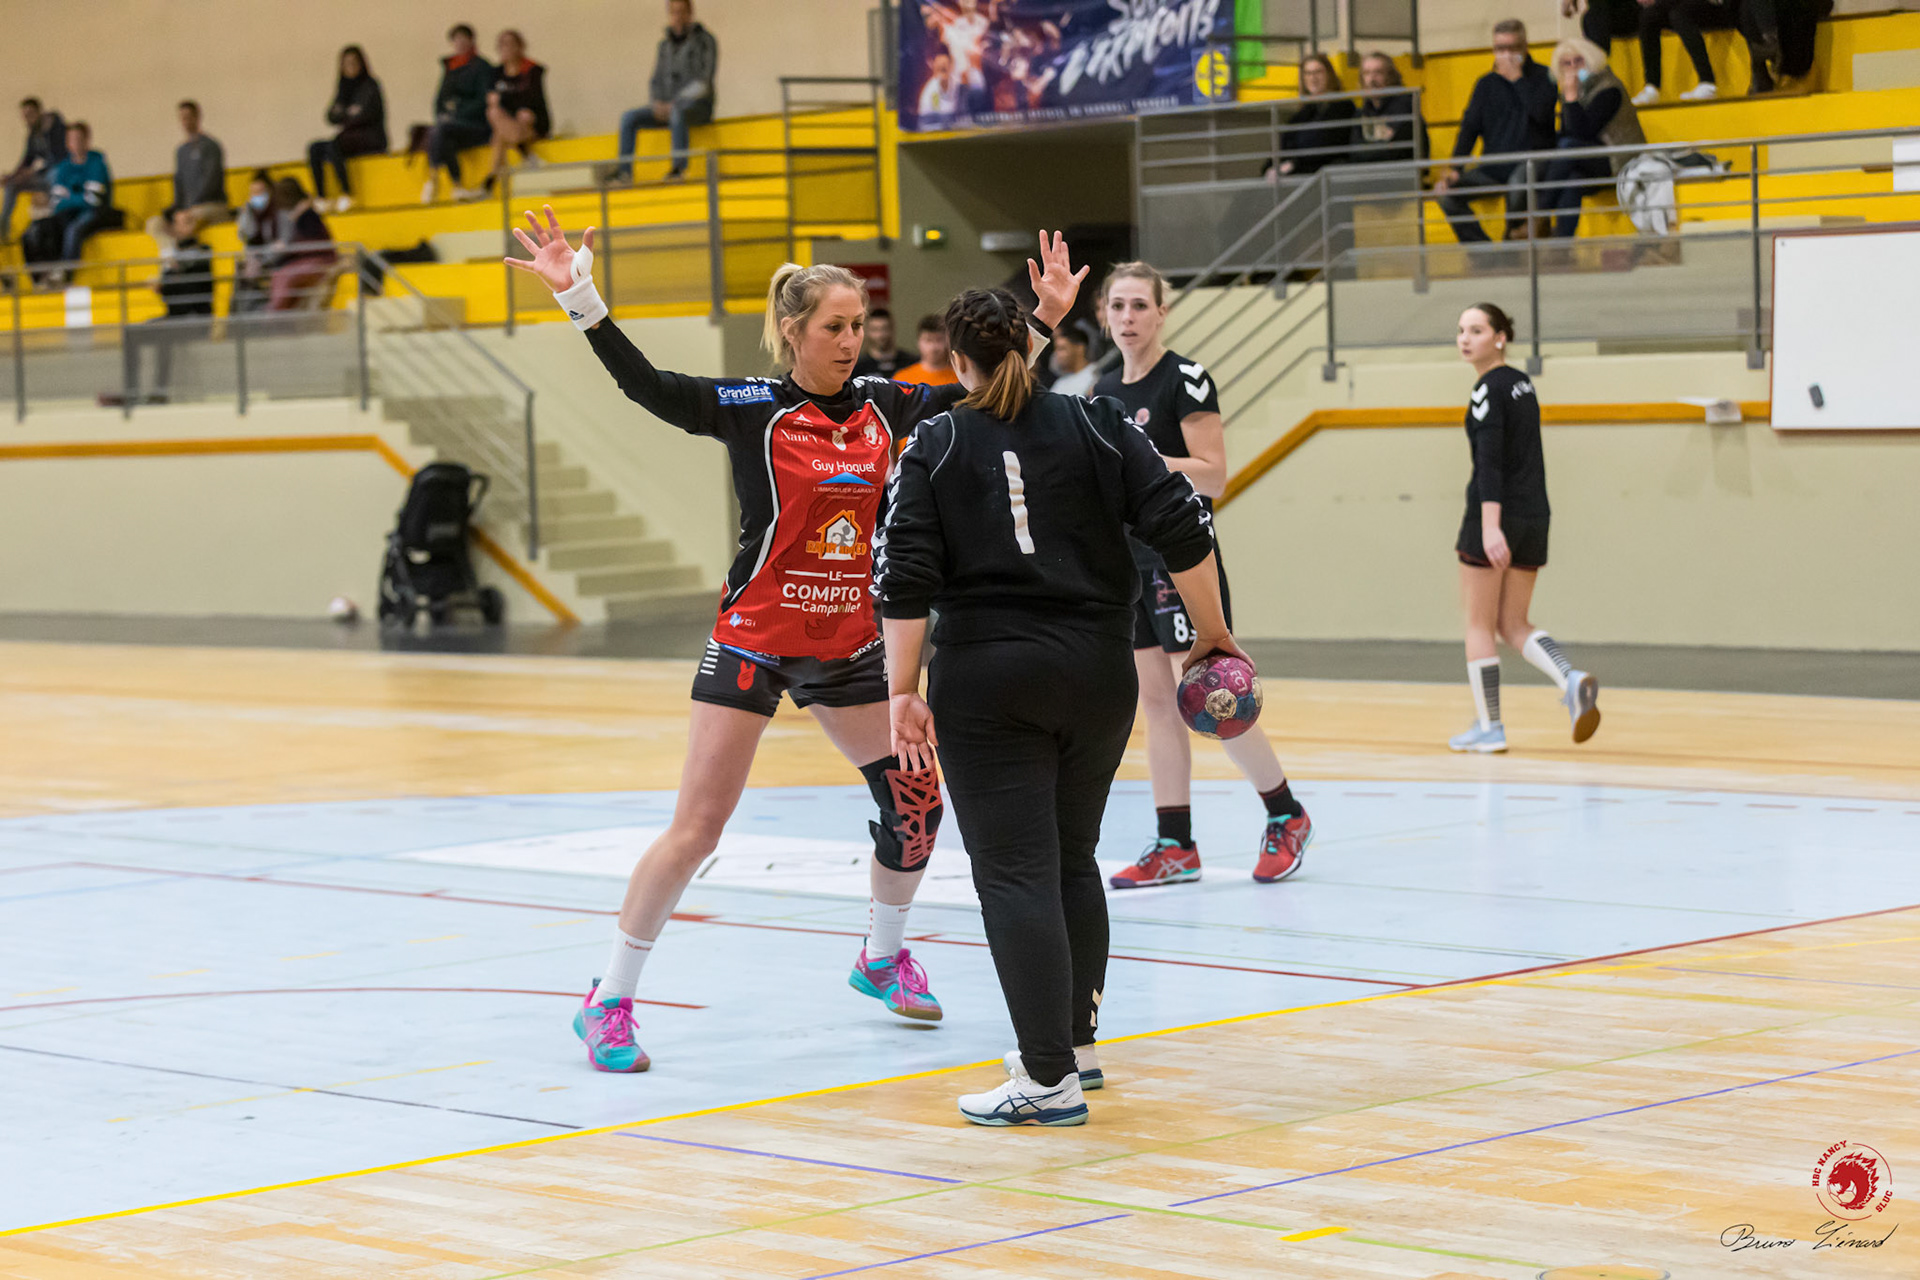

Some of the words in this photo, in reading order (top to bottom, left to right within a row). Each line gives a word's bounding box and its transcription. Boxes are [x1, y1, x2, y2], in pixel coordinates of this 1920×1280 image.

[811, 458, 834, 474] Guy
[836, 460, 877, 475] Hoquet
[1002, 450, 1036, 554] 1
[828, 570, 843, 581] LE
